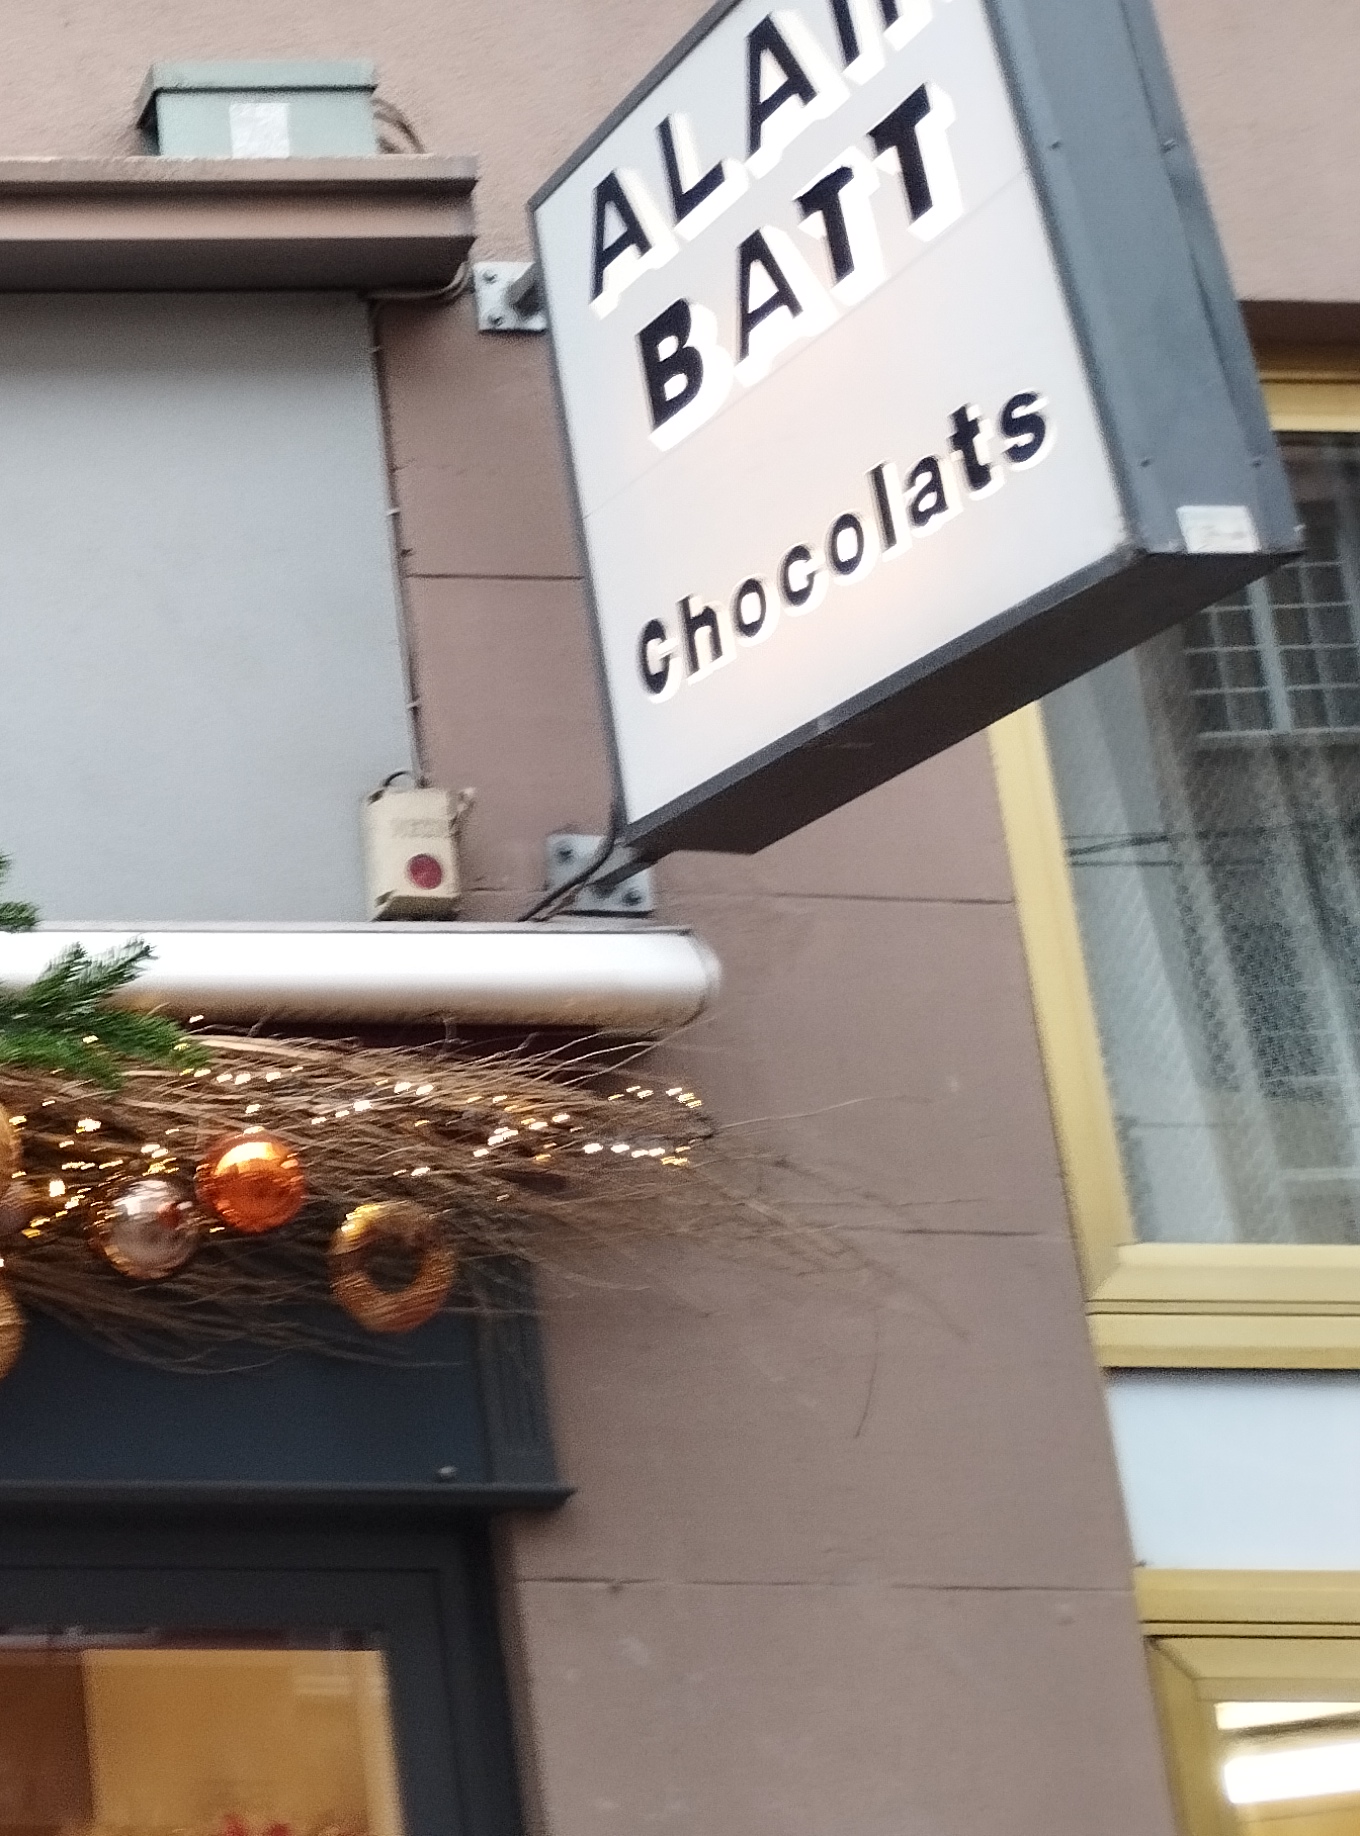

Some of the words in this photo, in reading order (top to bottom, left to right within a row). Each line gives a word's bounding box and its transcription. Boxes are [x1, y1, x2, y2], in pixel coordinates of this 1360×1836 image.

[591, 0, 928, 302] ALAI
[635, 83, 934, 432] BATT
[638, 391, 1050, 697] Chocolats
